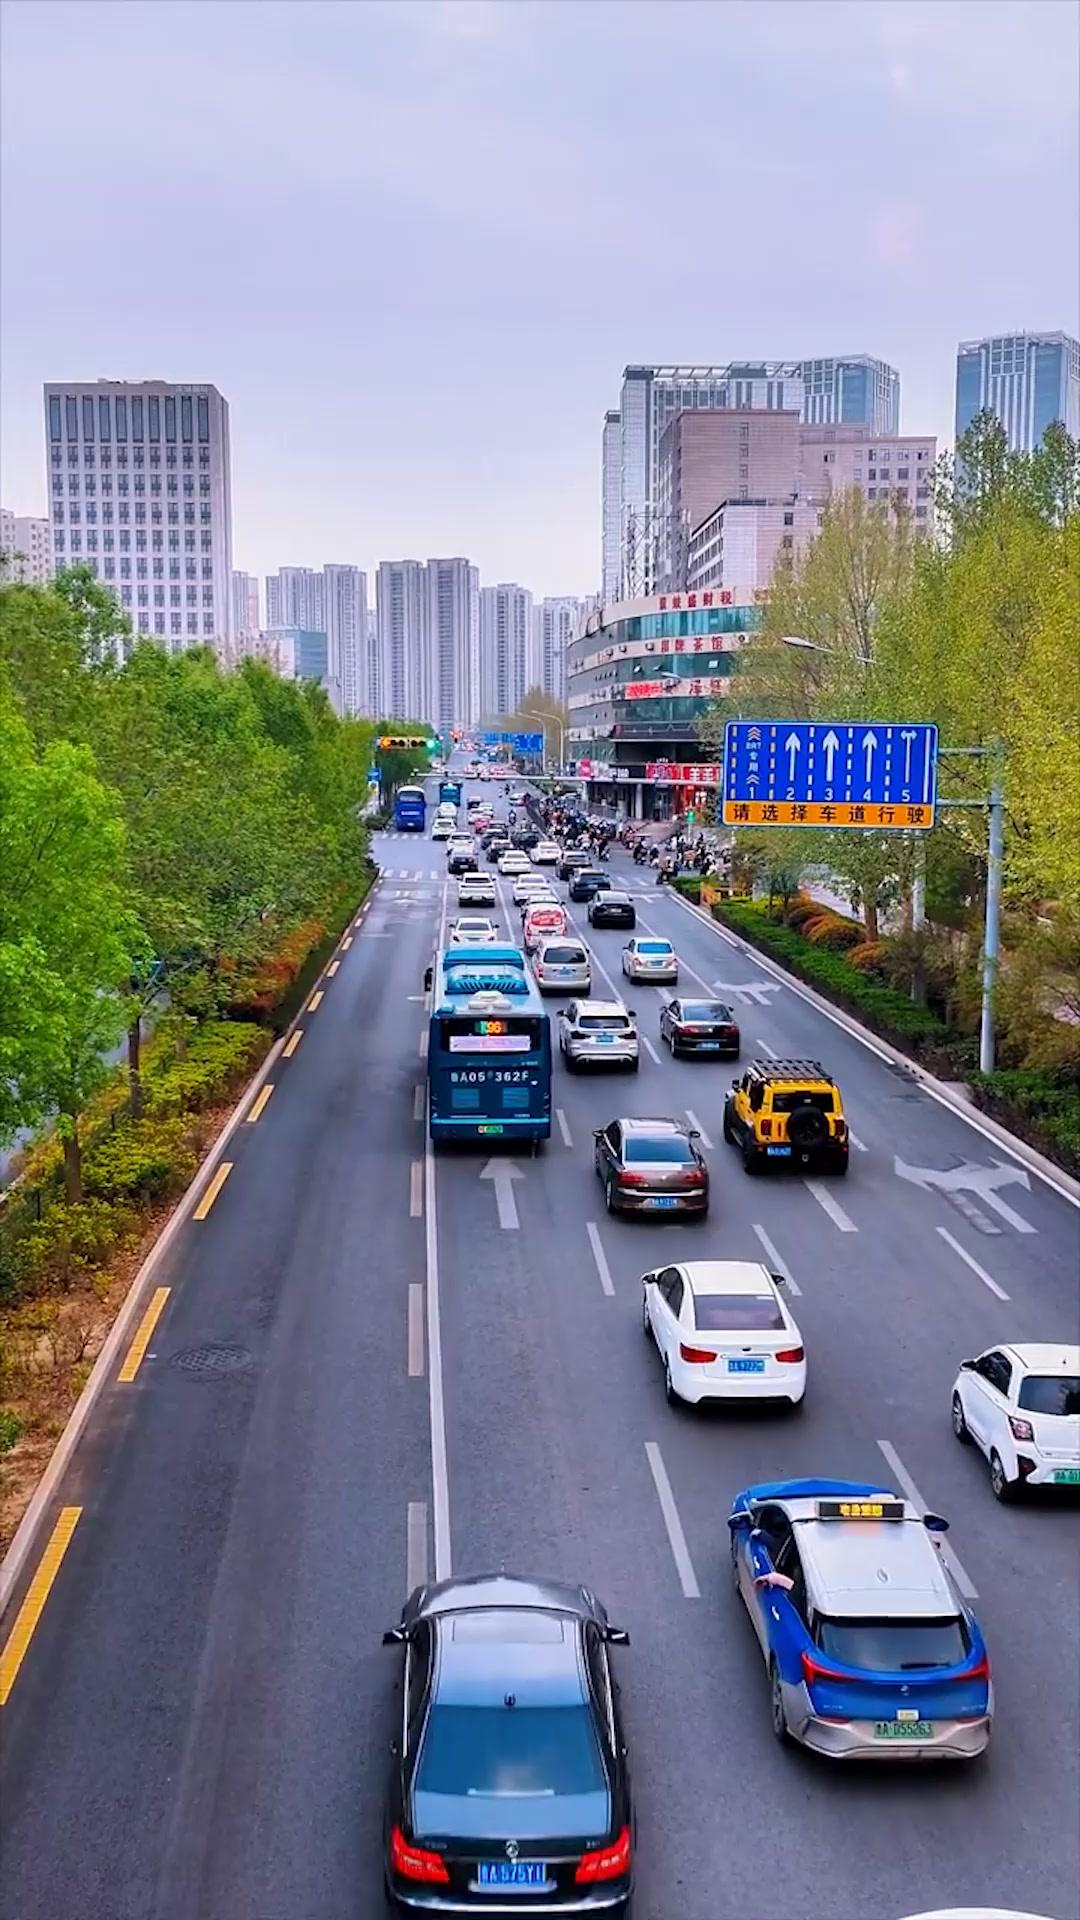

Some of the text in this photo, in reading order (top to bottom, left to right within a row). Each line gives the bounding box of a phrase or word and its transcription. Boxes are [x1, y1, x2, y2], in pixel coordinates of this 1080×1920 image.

[749, 788, 911, 801] 1 2 3 4 5
[733, 805, 924, 824] 请选择车道行驶
